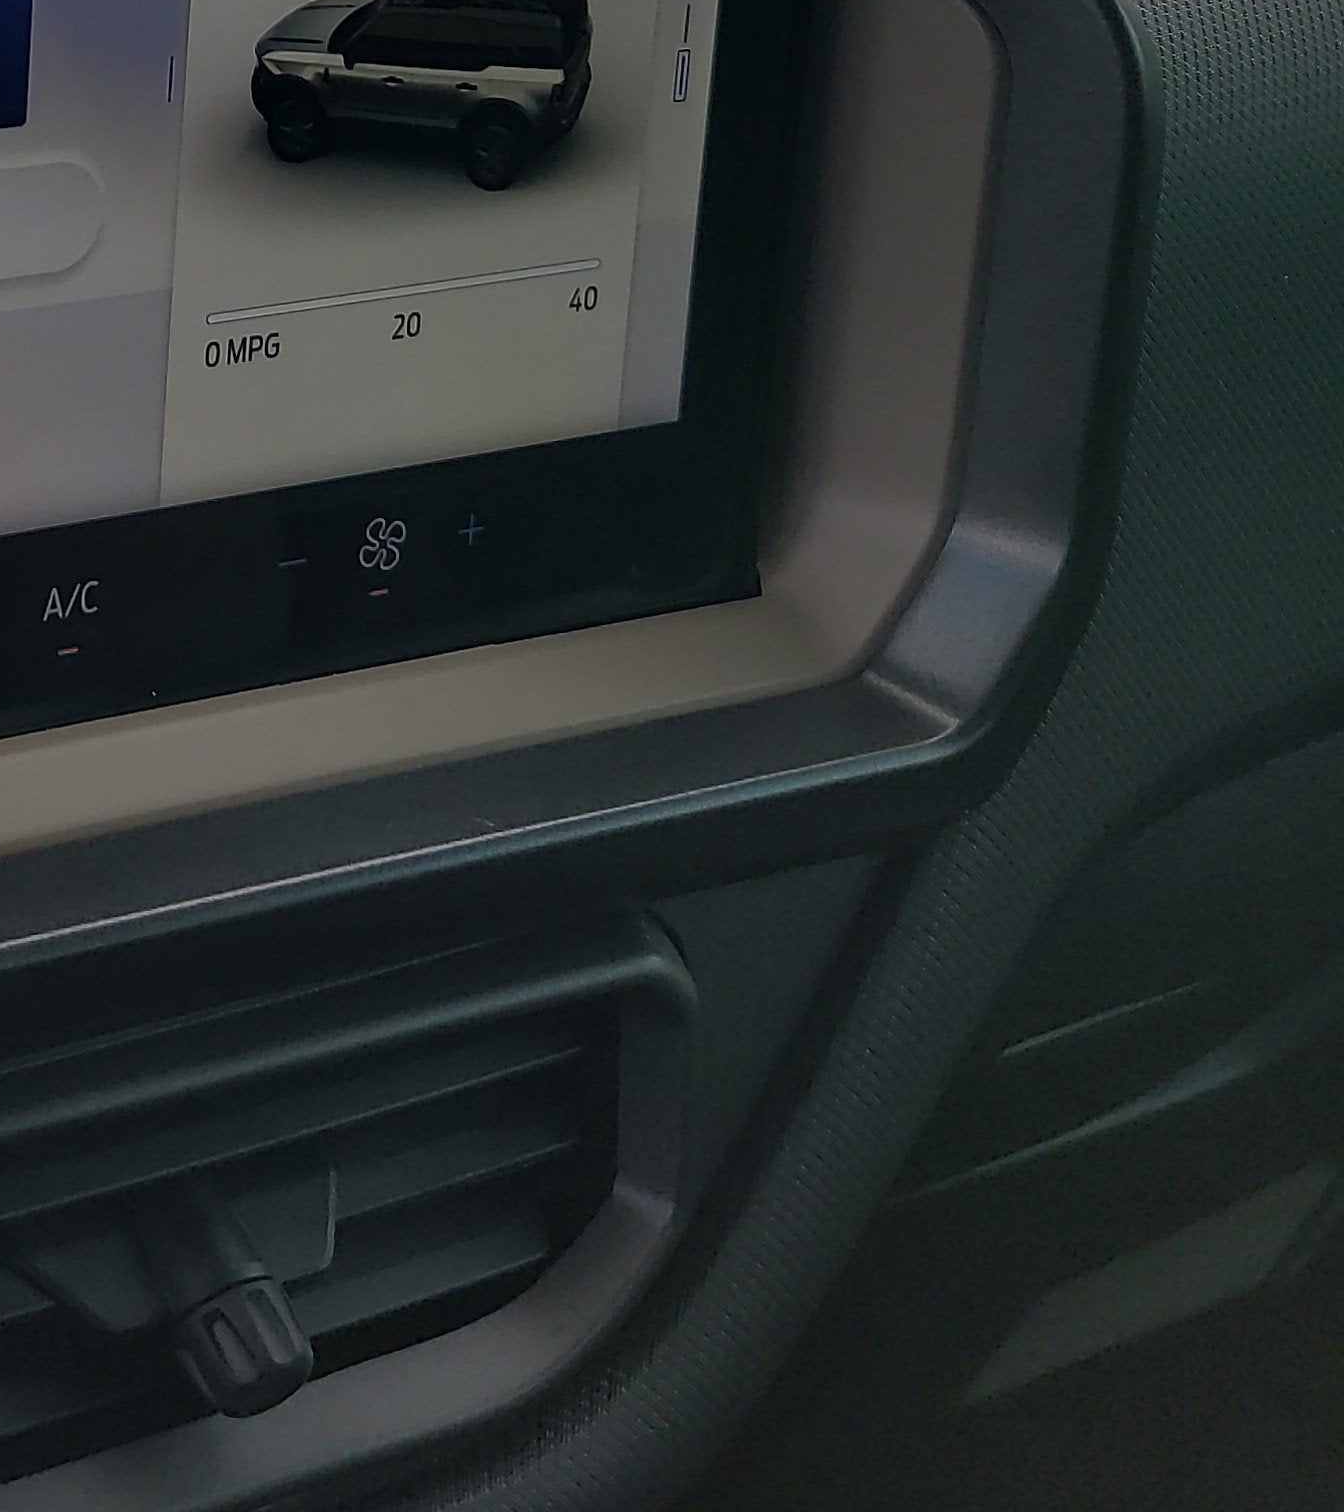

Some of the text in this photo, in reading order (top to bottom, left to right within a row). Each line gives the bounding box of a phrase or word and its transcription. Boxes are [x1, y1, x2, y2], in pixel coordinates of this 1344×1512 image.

[569, 286, 597, 312] 40
[392, 312, 420, 340] 20
[206, 333, 280, 367] 0 MPG
[43, 581, 99, 621] A/C
